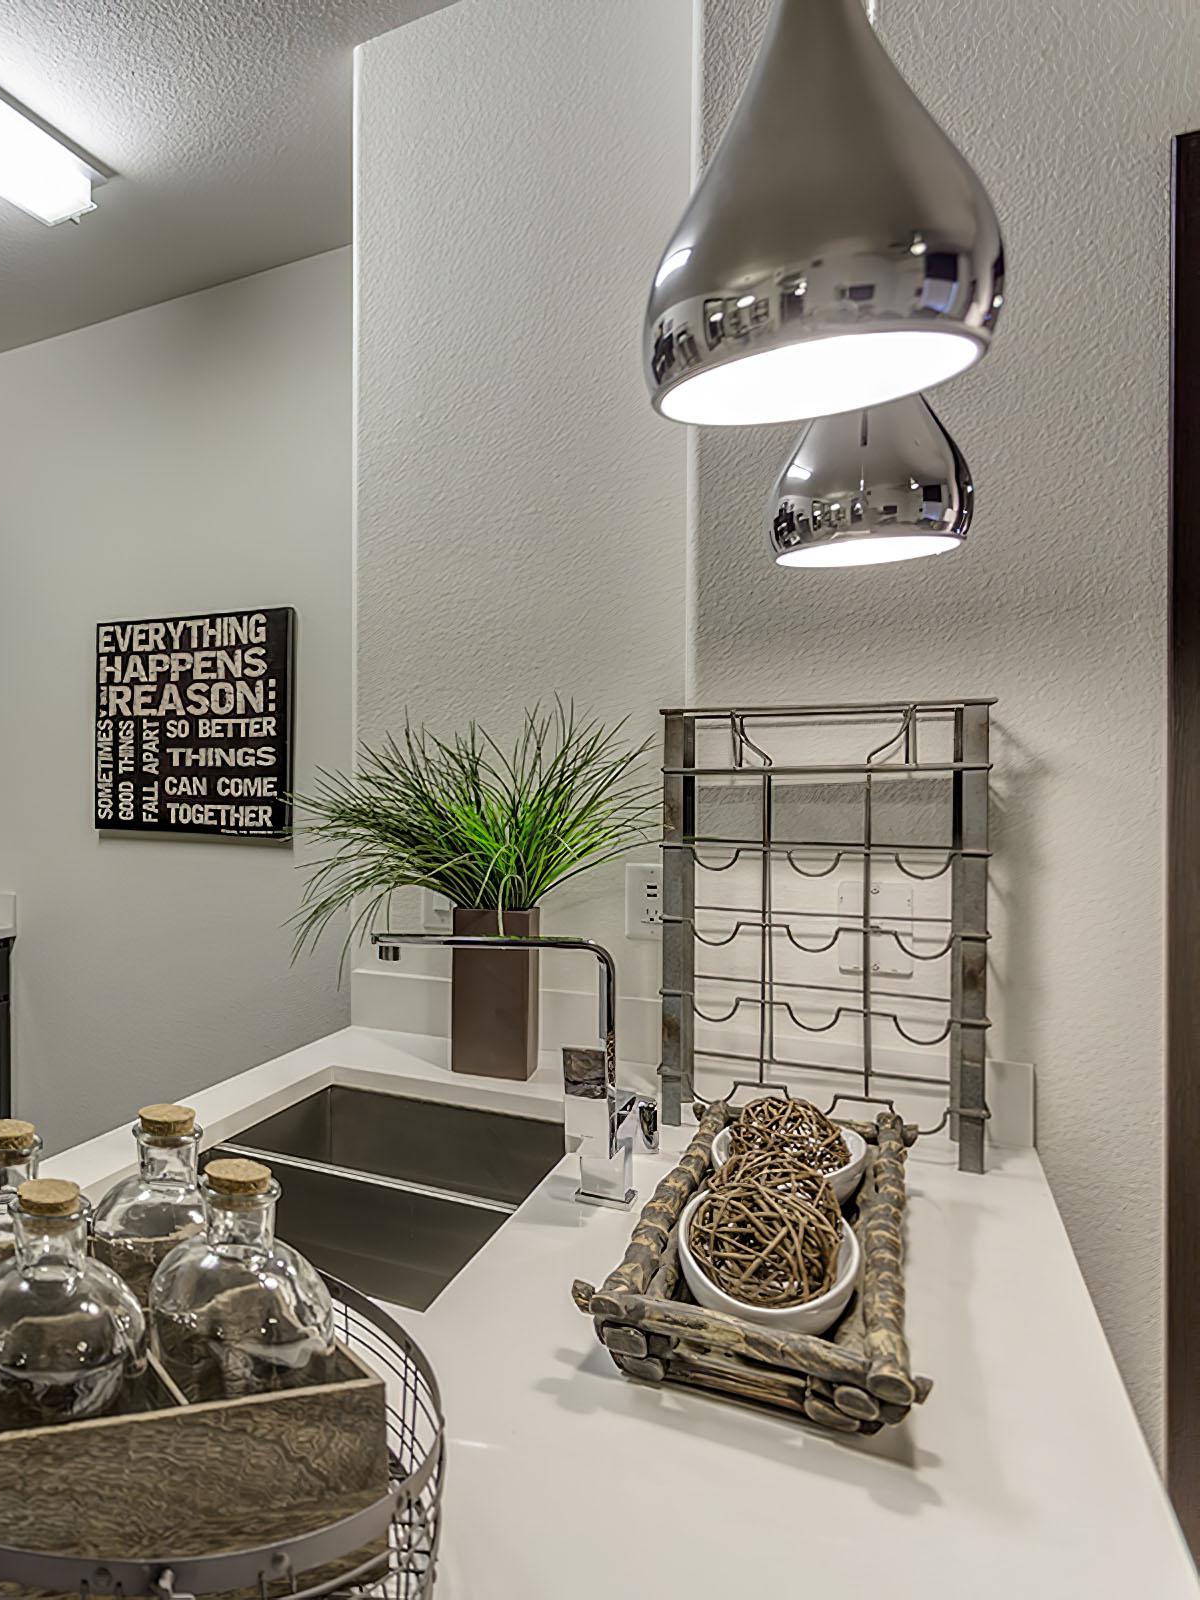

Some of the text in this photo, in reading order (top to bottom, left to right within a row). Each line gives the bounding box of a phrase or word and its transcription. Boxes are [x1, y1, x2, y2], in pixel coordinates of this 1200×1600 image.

[98, 613, 267, 653] EVERYTHING
[98, 646, 268, 683] HAPPENS
[166, 716, 277, 738] SO BETTER
[97, 718, 113, 820] SOMETIMES
[118, 720, 135, 820] GOOD THINGS
[142, 719, 159, 822] FALL APART
[166, 746, 277, 767] THINGS
[164, 776, 278, 797] CAN COME
[166, 803, 274, 827] TOGETHER
